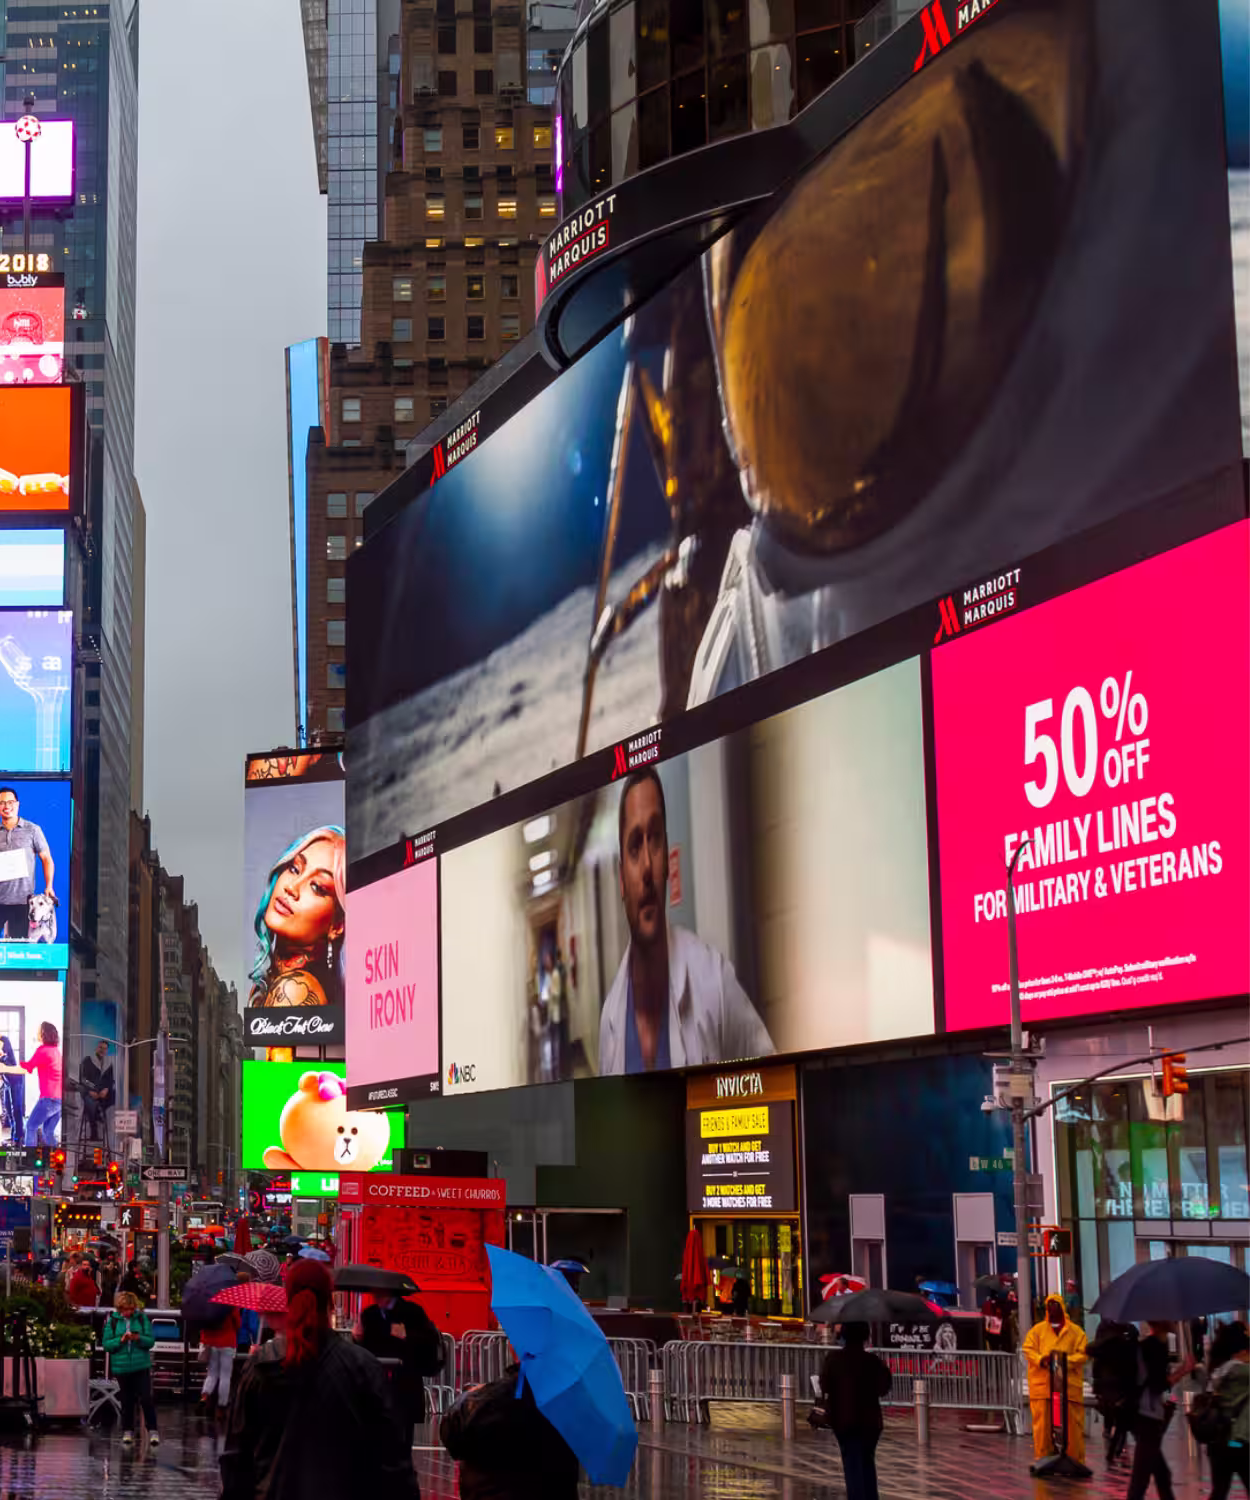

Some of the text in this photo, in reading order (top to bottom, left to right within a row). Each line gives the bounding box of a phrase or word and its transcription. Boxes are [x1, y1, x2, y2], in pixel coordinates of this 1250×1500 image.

[549, 194, 617, 257] MARRIOTT
[549, 226, 608, 283] MARQUIS
[7, 274, 39, 287] bubly
[446, 410, 482, 450] MARRIOTT
[447, 431, 478, 467] MARQUIS
[963, 567, 1022, 606] MARRIOTT
[963, 592, 1015, 625] MARQUIS
[628, 728, 663, 753] MARRIOTT
[1023, 670, 1149, 809] 50%
[628, 746, 660, 768] MARQUIS
[1103, 739, 1151, 789] OFF
[1003, 793, 1177, 872] FAMILY LINES
[973, 840, 1224, 924] FOR MILITARY & VETERANS
[365, 940, 400, 985] SKIN
[370, 983, 417, 1030] IRONY
[250, 1015, 335, 1036] Black Ink Crew
[459, 1064, 477, 1084] NBC
[716, 1072, 763, 1099] INVICTA
[702, 1116, 725, 1132] FRIENDS
[731, 1115, 751, 1130] FAMILY
[751, 1112, 766, 1129] SALE
[701, 1151, 770, 1165] ANOTHER WATCH FOR FREE
[708, 1143, 719, 1154] BUY
[722, 1142, 740, 1153] WATCH
[740, 1142, 752, 1152] AND
[751, 1140, 762, 1152] GET
[369, 1184, 431, 1198] COFFEED
[437, 1185, 462, 1199] SWEET
[465, 1188, 501, 1200] CHURROS
[706, 1185, 717, 1196] BUY
[719, 1184, 743, 1196] WATCHES
[743, 1184, 755, 1195] AND
[755, 1184, 766, 1195] GET
[707, 1197, 722, 1208] MORE
[722, 1196, 746, 1208] WATCHES
[746, 1196, 757, 1207] FOR
[757, 1196, 773, 1208] FREE
